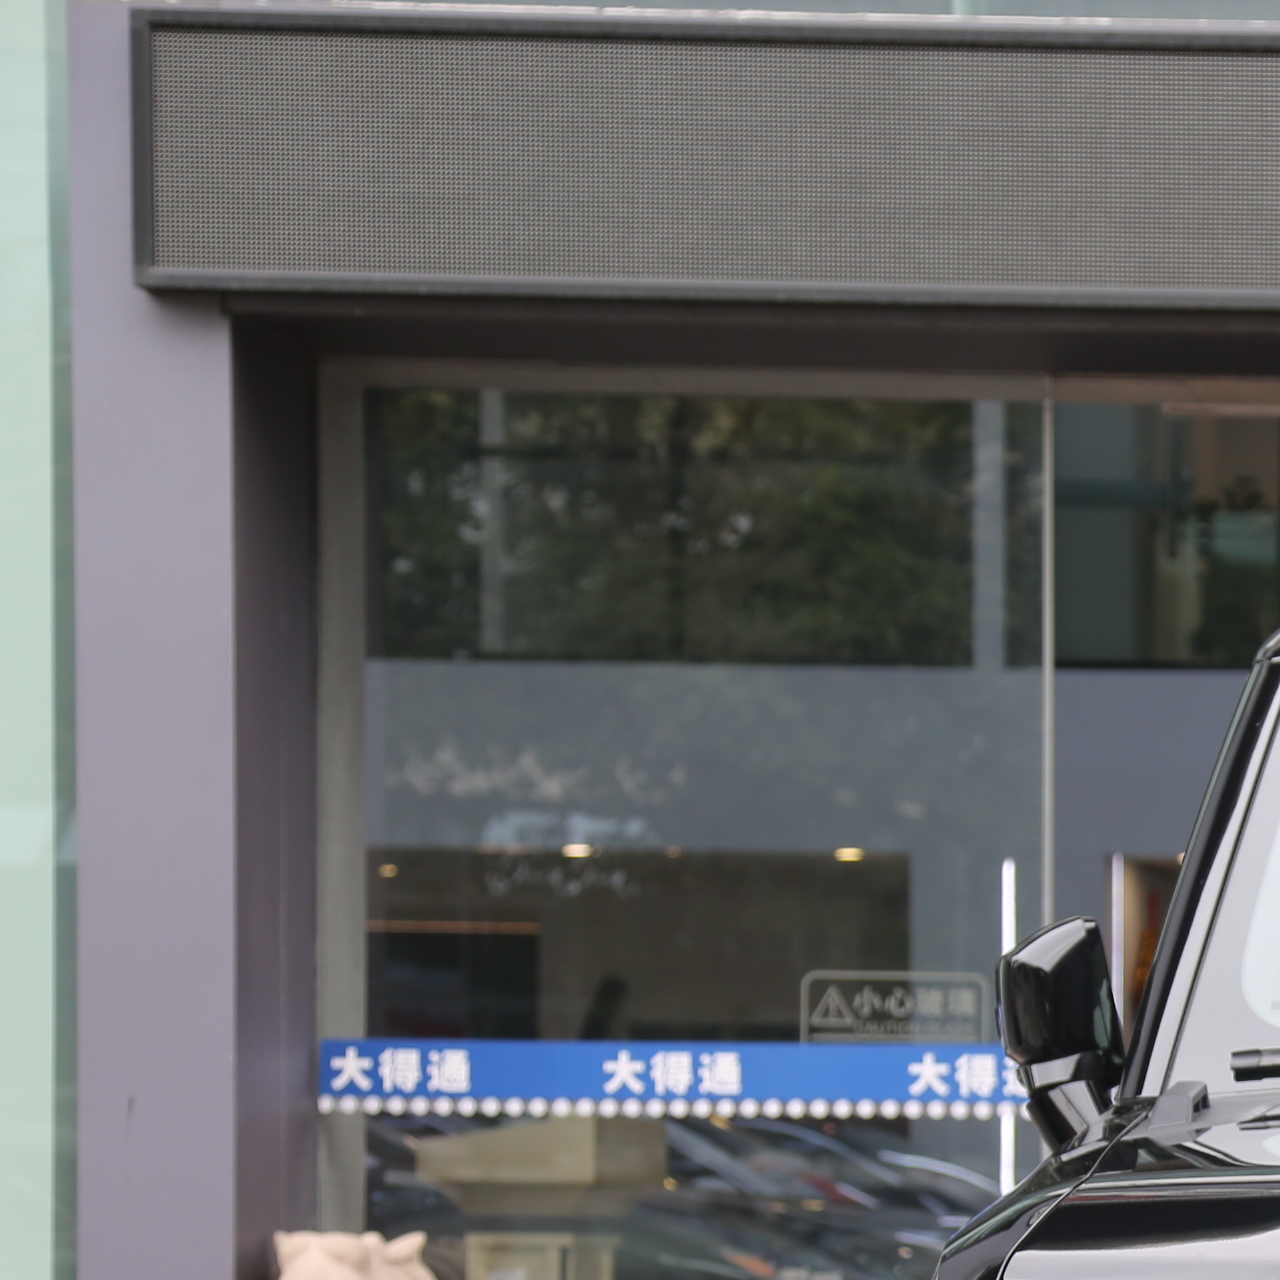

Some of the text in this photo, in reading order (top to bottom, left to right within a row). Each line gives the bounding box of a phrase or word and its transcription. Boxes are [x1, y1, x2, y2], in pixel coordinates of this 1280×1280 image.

[330, 1047, 471, 1093] 大得通
[602, 1049, 742, 1095] 大得通
